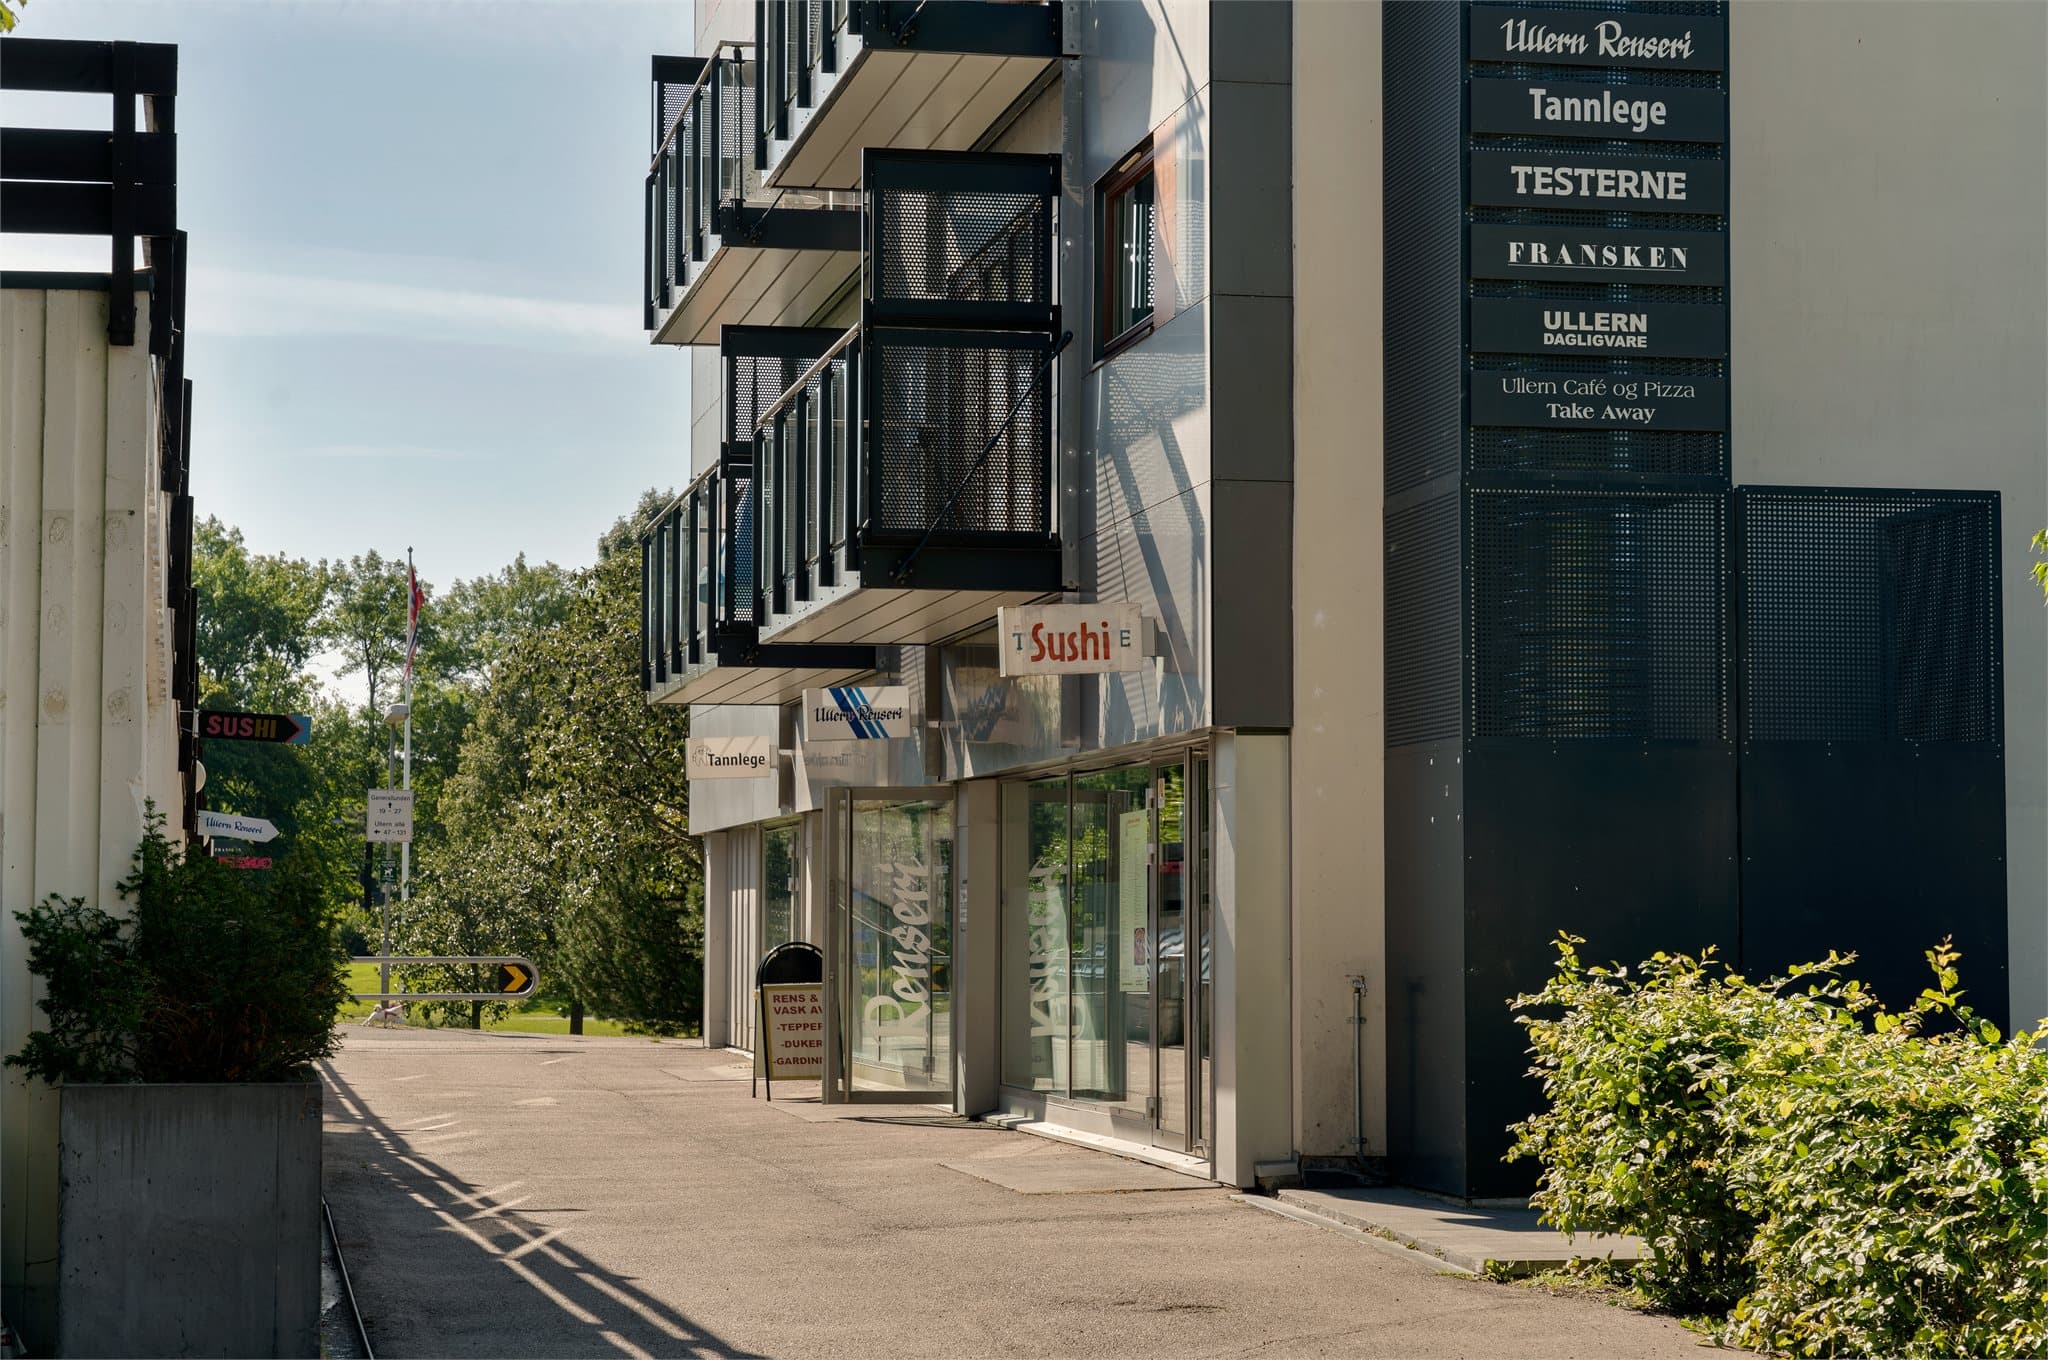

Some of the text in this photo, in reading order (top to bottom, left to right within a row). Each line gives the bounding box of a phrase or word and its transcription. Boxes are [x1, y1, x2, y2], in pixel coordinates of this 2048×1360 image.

[1500, 18, 1695, 60] Ullern Renseri
[1529, 88, 1667, 133] Tannlege
[1510, 165, 1687, 200] TESTERNE
[1508, 241, 1689, 269] FRANSKEN
[1543, 310, 1648, 333] ULLERN
[1543, 333, 1648, 348] DAGLIGVARE
[1502, 378, 1696, 400] Ullern Café og Pizza
[1546, 403, 1656, 424] Take Away
[1030, 621, 1111, 663] Sushi
[813, 704, 904, 723] Ullern Renseri
[206, 714, 277, 738] SUSHI
[707, 753, 766, 769] Tannlege
[206, 816, 263, 834] Ullern Renseri
[864, 856, 932, 1046] Renseri
[773, 993, 819, 1003] RENS &
[773, 1006, 806, 1015] VASK
